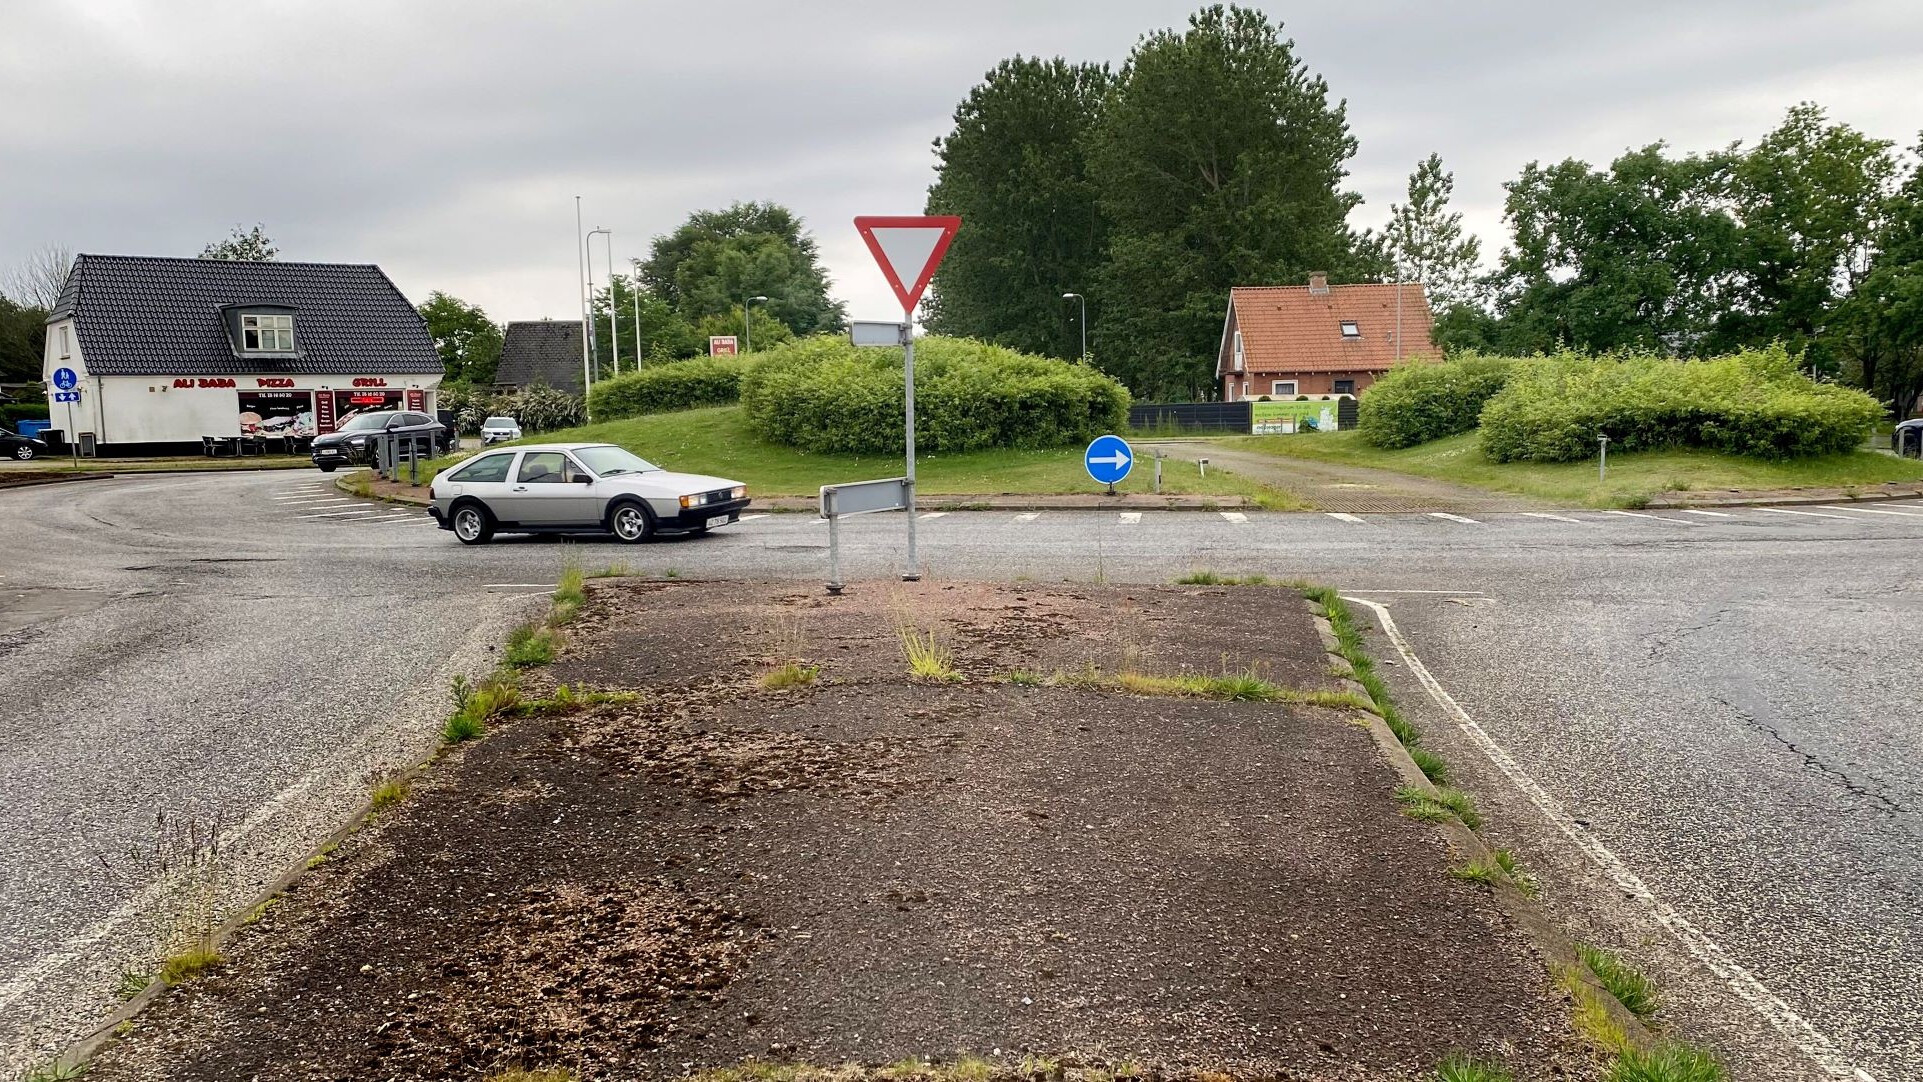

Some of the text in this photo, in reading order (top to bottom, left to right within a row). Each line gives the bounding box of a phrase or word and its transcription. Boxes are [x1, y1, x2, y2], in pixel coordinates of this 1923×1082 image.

[174, 378, 387, 388] ALI BABA PIZZA GRILL
